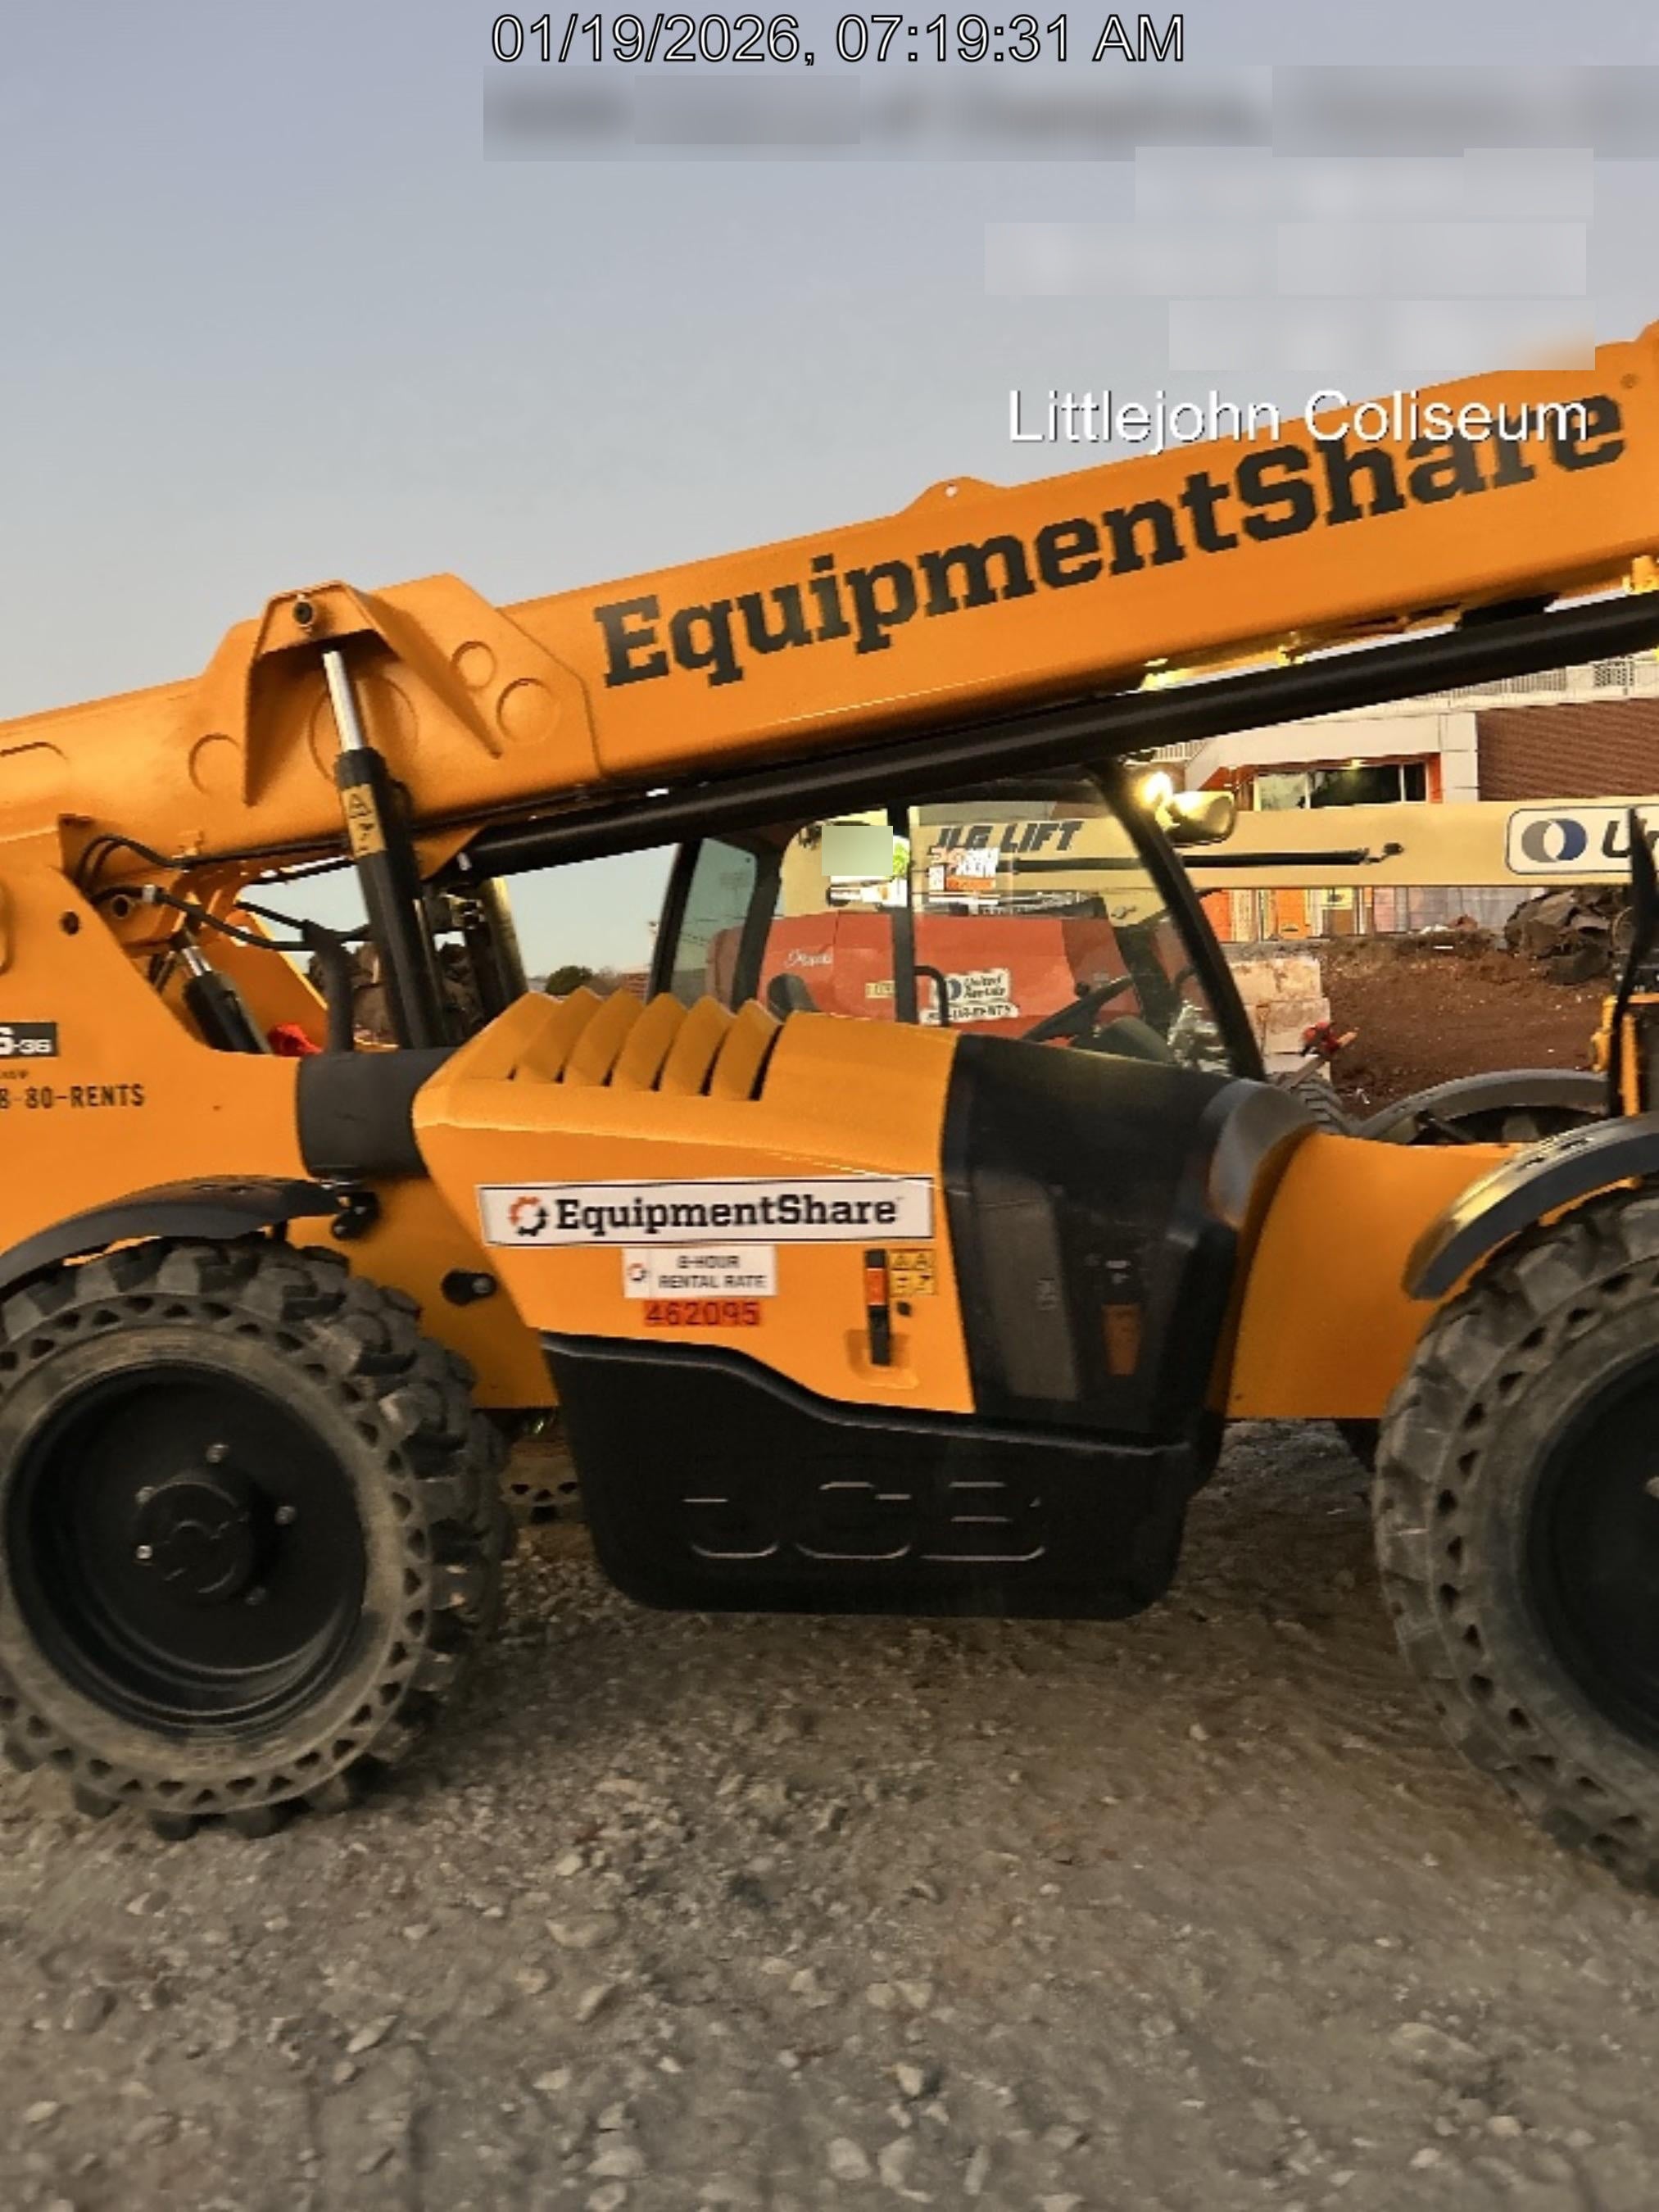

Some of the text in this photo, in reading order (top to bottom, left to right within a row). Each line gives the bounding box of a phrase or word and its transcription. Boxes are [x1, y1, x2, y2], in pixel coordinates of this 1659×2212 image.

[593, 393, 1627, 688] EquipmentShare
[999, 820, 1084, 854] LIFT
[555, 1194, 897, 1235] EquipmentShare
[659, 1274, 765, 1290] RENTAL RATE
[645, 1300, 762, 1326] 462095
